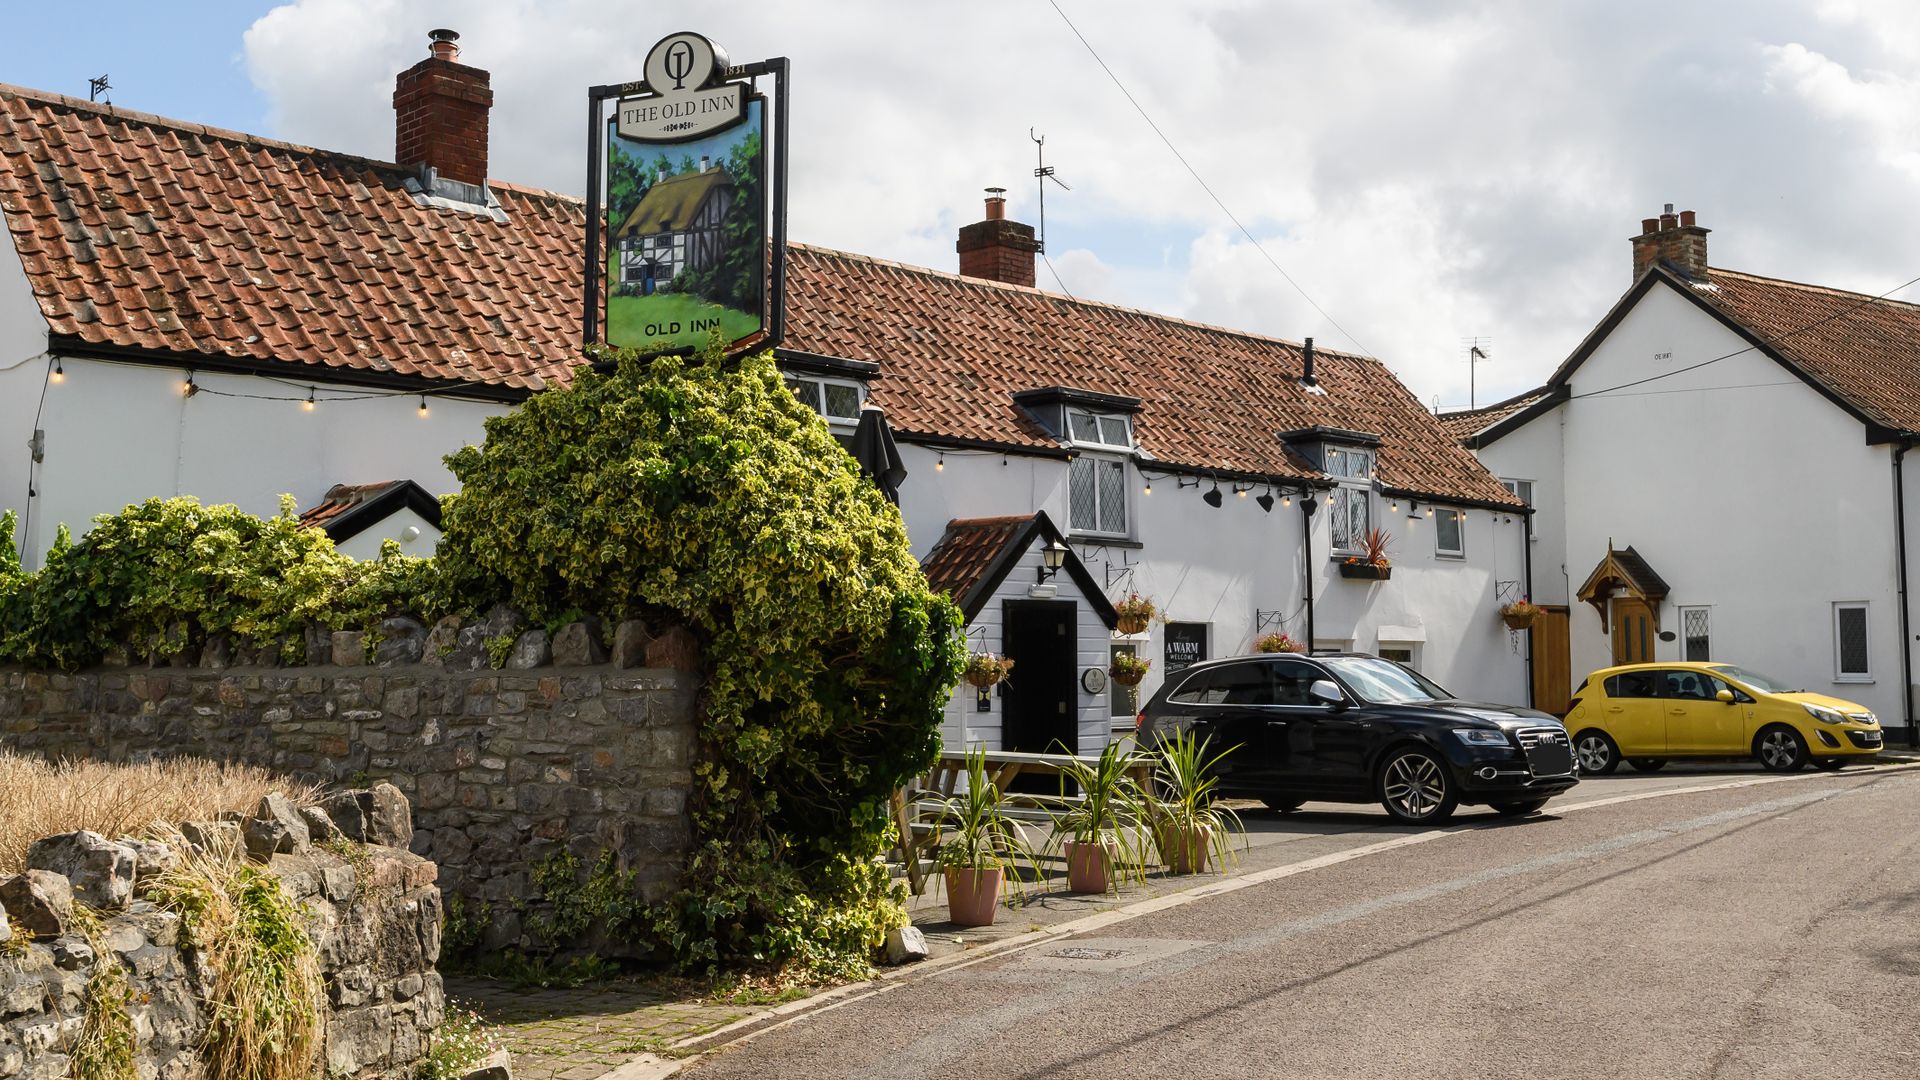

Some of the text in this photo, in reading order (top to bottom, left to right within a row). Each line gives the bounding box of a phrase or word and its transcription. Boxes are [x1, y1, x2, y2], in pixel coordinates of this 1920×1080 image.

[624, 94, 735, 125] THE OLD INN
[645, 317, 721, 337] OLD INN
[1166, 642, 1199, 654] A WARM
